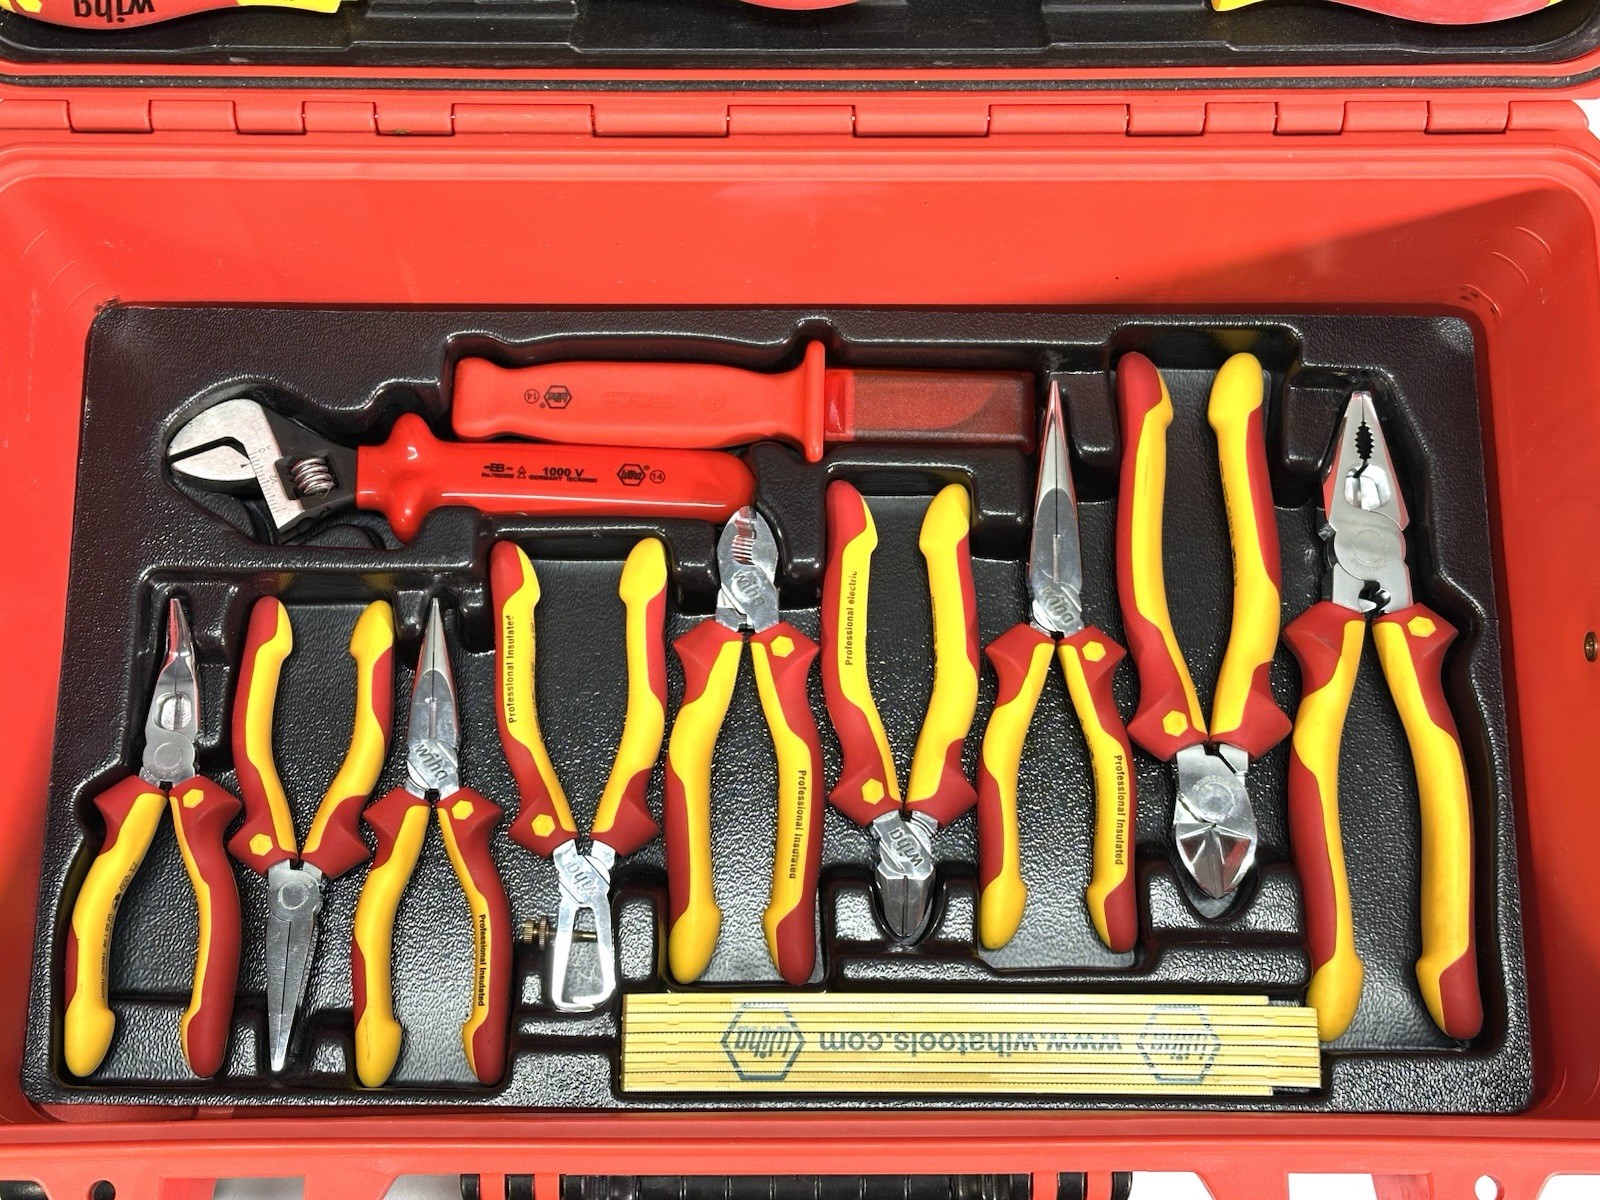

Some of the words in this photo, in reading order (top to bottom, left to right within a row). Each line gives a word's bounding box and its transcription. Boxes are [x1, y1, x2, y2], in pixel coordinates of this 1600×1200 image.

[73, 0, 155, 23] wiha
[543, 466, 571, 477] 1000
[575, 468, 585, 477] V
[846, 570, 858, 605] electric
[505, 614, 515, 659] Insulated
[844, 607, 855, 666] Professional
[505, 662, 517, 724] Professional
[414, 742, 449, 782] wiha
[794, 769, 808, 831] Professional
[1113, 754, 1126, 816] Professional
[888, 827, 924, 868] wiha
[1114, 819, 1126, 866] Insulated
[478, 913, 488, 966] Professional
[477, 967, 487, 1007] Insulated
[818, 1031, 1124, 1058] www.wihatools.com
